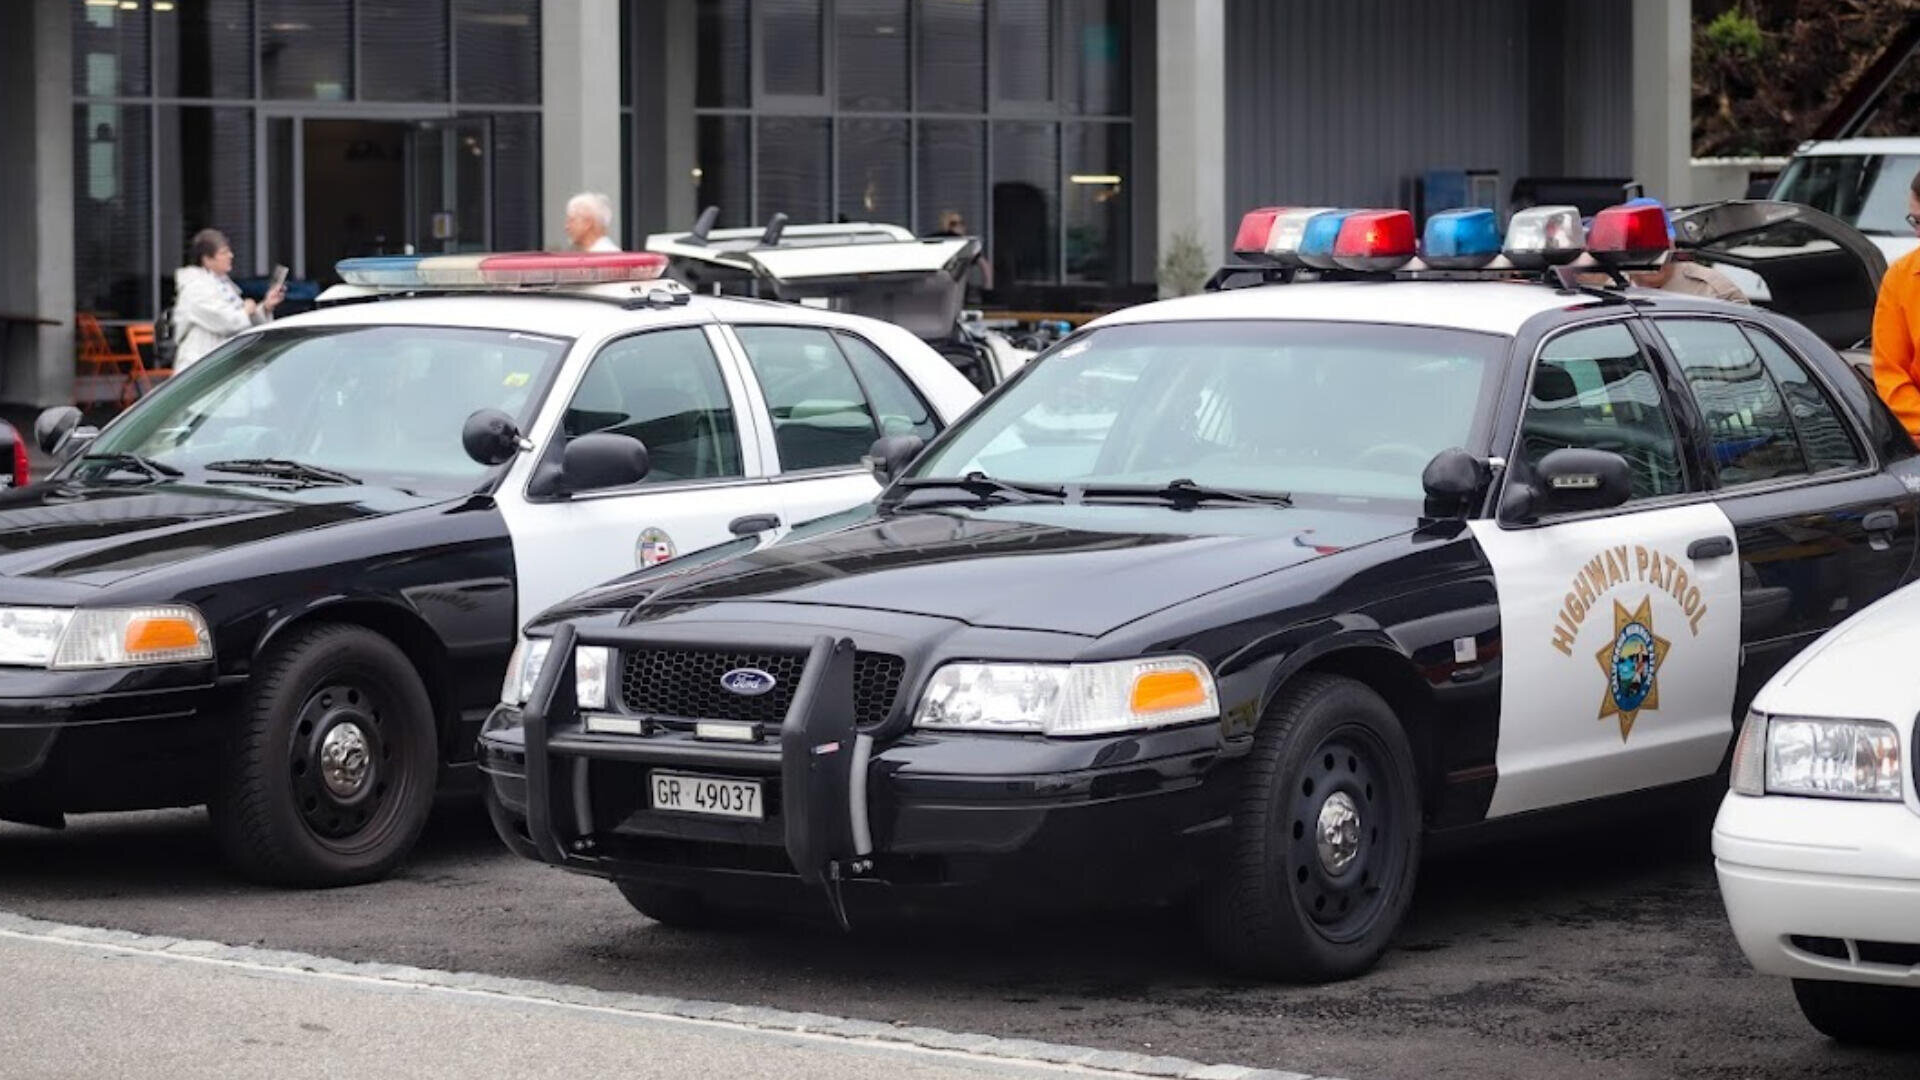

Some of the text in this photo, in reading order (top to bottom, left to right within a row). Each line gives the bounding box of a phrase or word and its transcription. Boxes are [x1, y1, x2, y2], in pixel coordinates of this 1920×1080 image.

[1552, 545, 1707, 657] HIGHWAY PATROL
[657, 779, 755, 812] GR 49037
